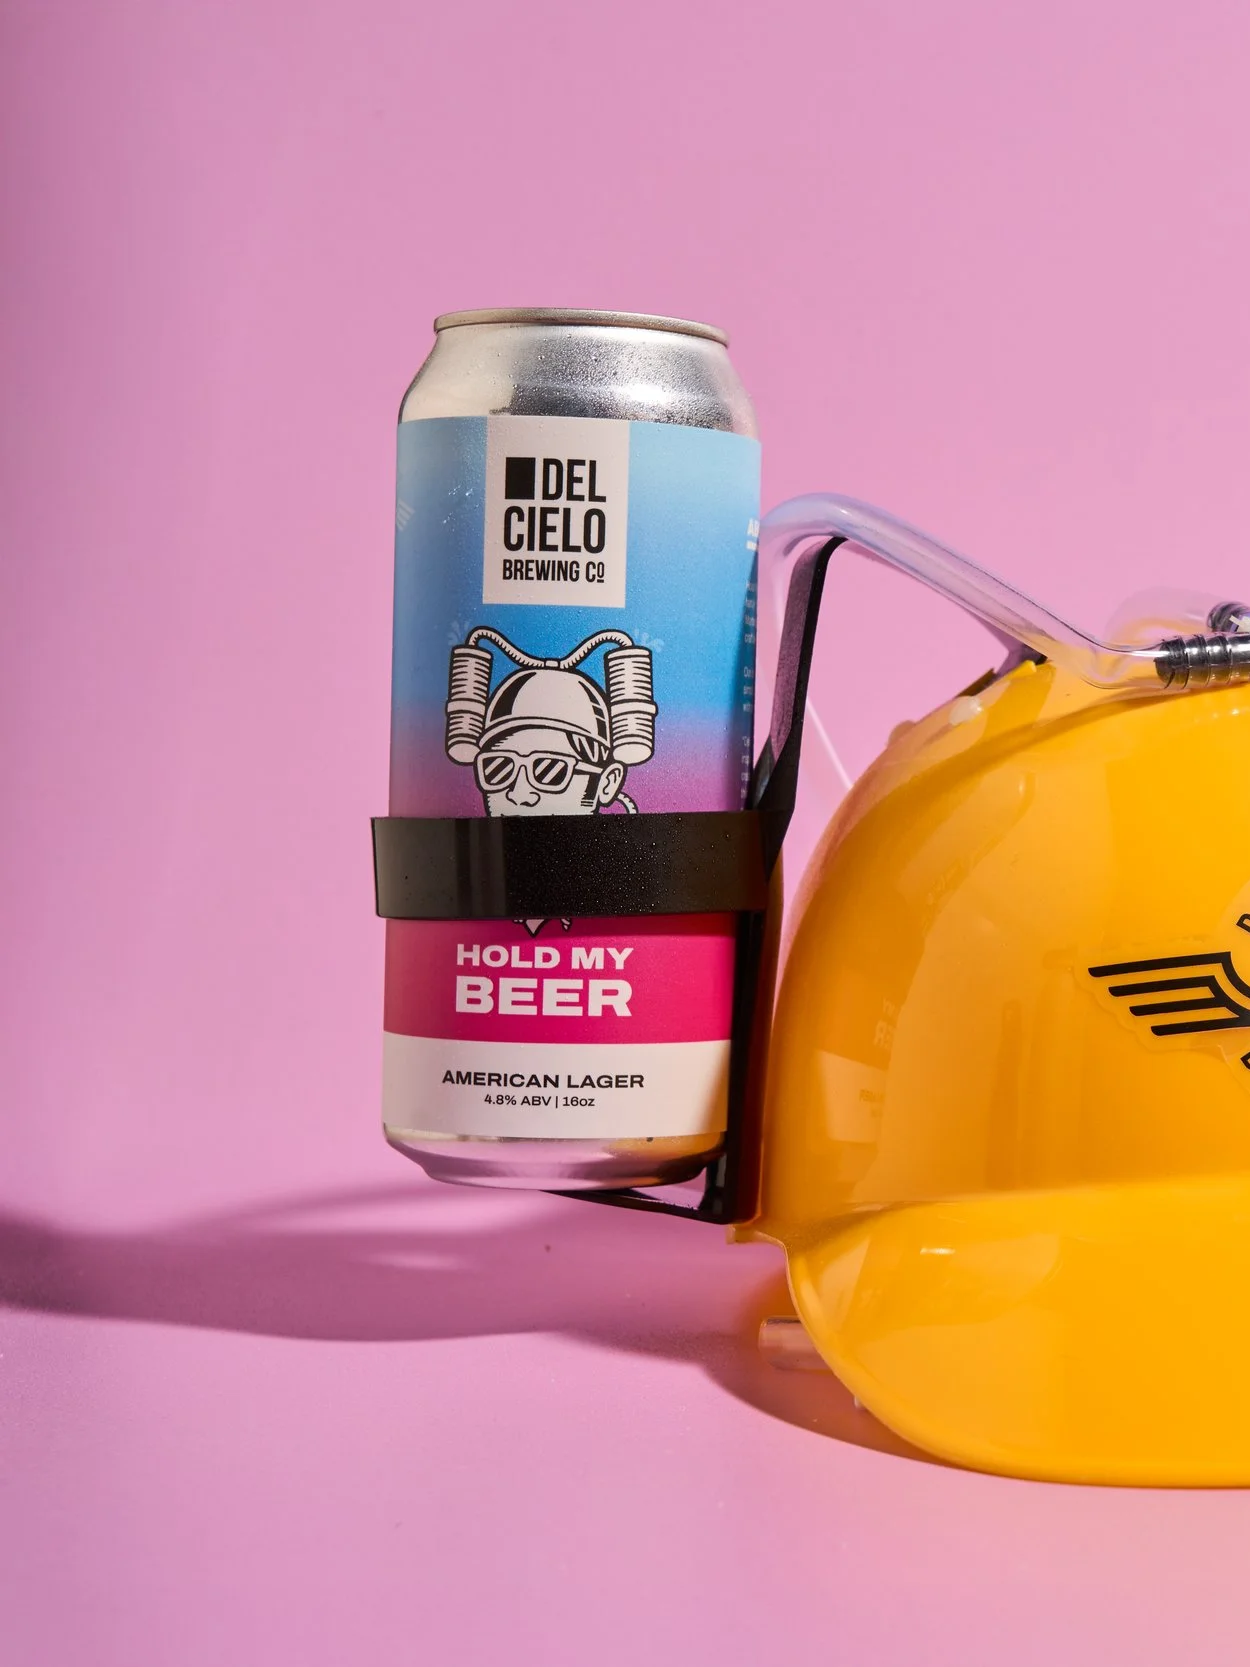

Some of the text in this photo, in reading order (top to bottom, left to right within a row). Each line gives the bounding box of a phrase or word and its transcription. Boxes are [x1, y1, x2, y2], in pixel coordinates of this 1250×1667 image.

[542, 458, 606, 503] DEL
[503, 506, 606, 554] CIELO
[502, 559, 580, 582] BREWING
[456, 943, 634, 970] HOLD MY
[455, 975, 633, 1017] BEER
[442, 1070, 645, 1089] AMERICAN LAGER
[484, 1094, 517, 1106] 4.8%
[520, 1095, 551, 1107] ABV
[562, 1095, 595, 1107] 16oz
